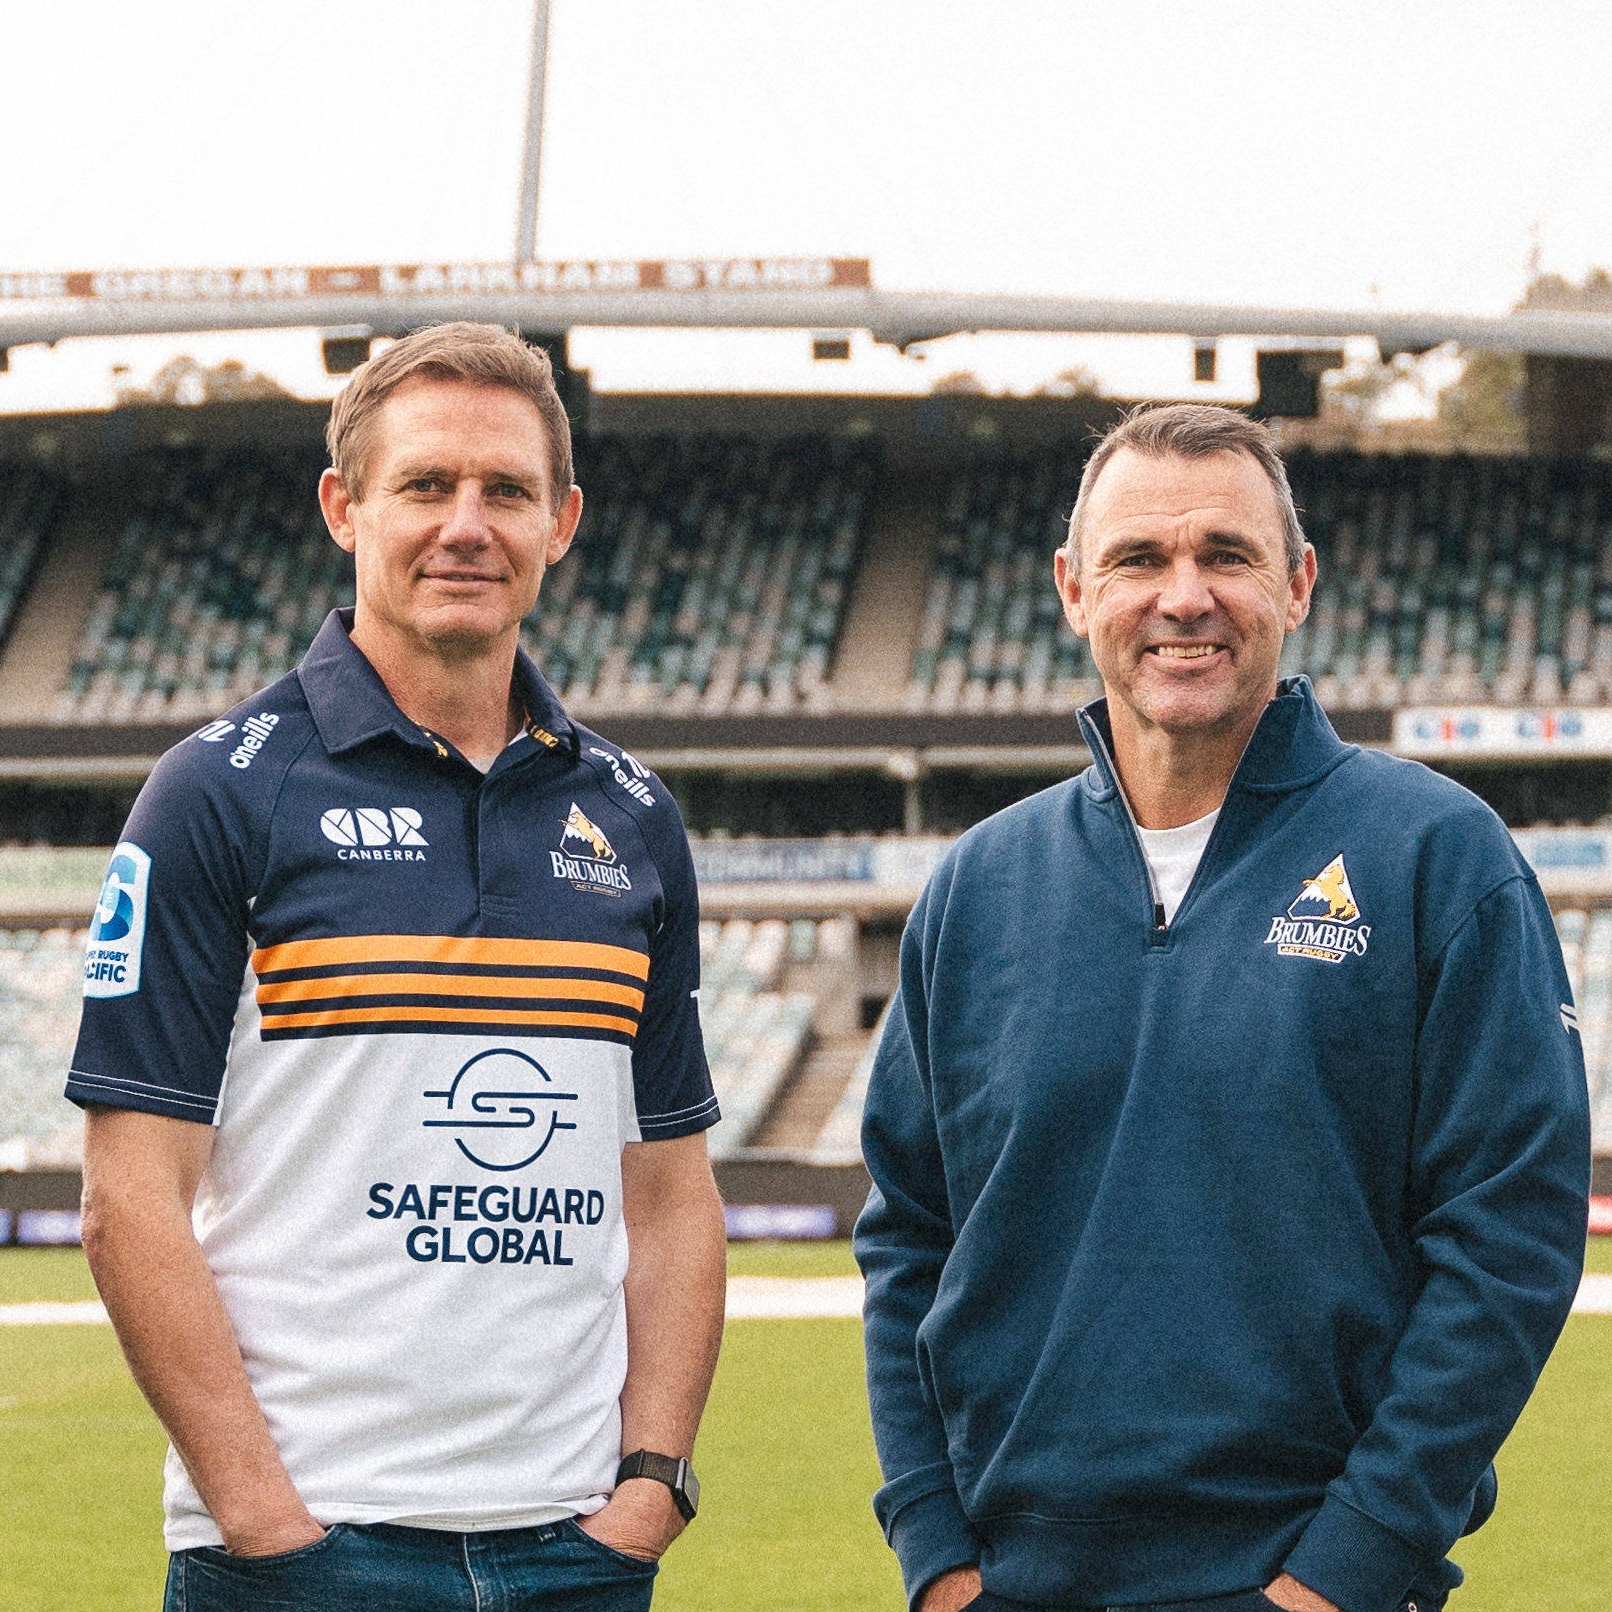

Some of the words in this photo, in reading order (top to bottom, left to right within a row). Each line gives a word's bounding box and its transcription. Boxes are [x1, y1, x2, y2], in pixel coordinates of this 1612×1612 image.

[337, 849, 426, 861] CANBERRA
[549, 851, 632, 890] BRUMBIES
[98, 950, 129, 962] RUGBY
[1264, 917, 1372, 956] BRUMBIES
[366, 1182, 605, 1226] SAFEGUARD
[406, 1225, 573, 1265] GLOBAL
